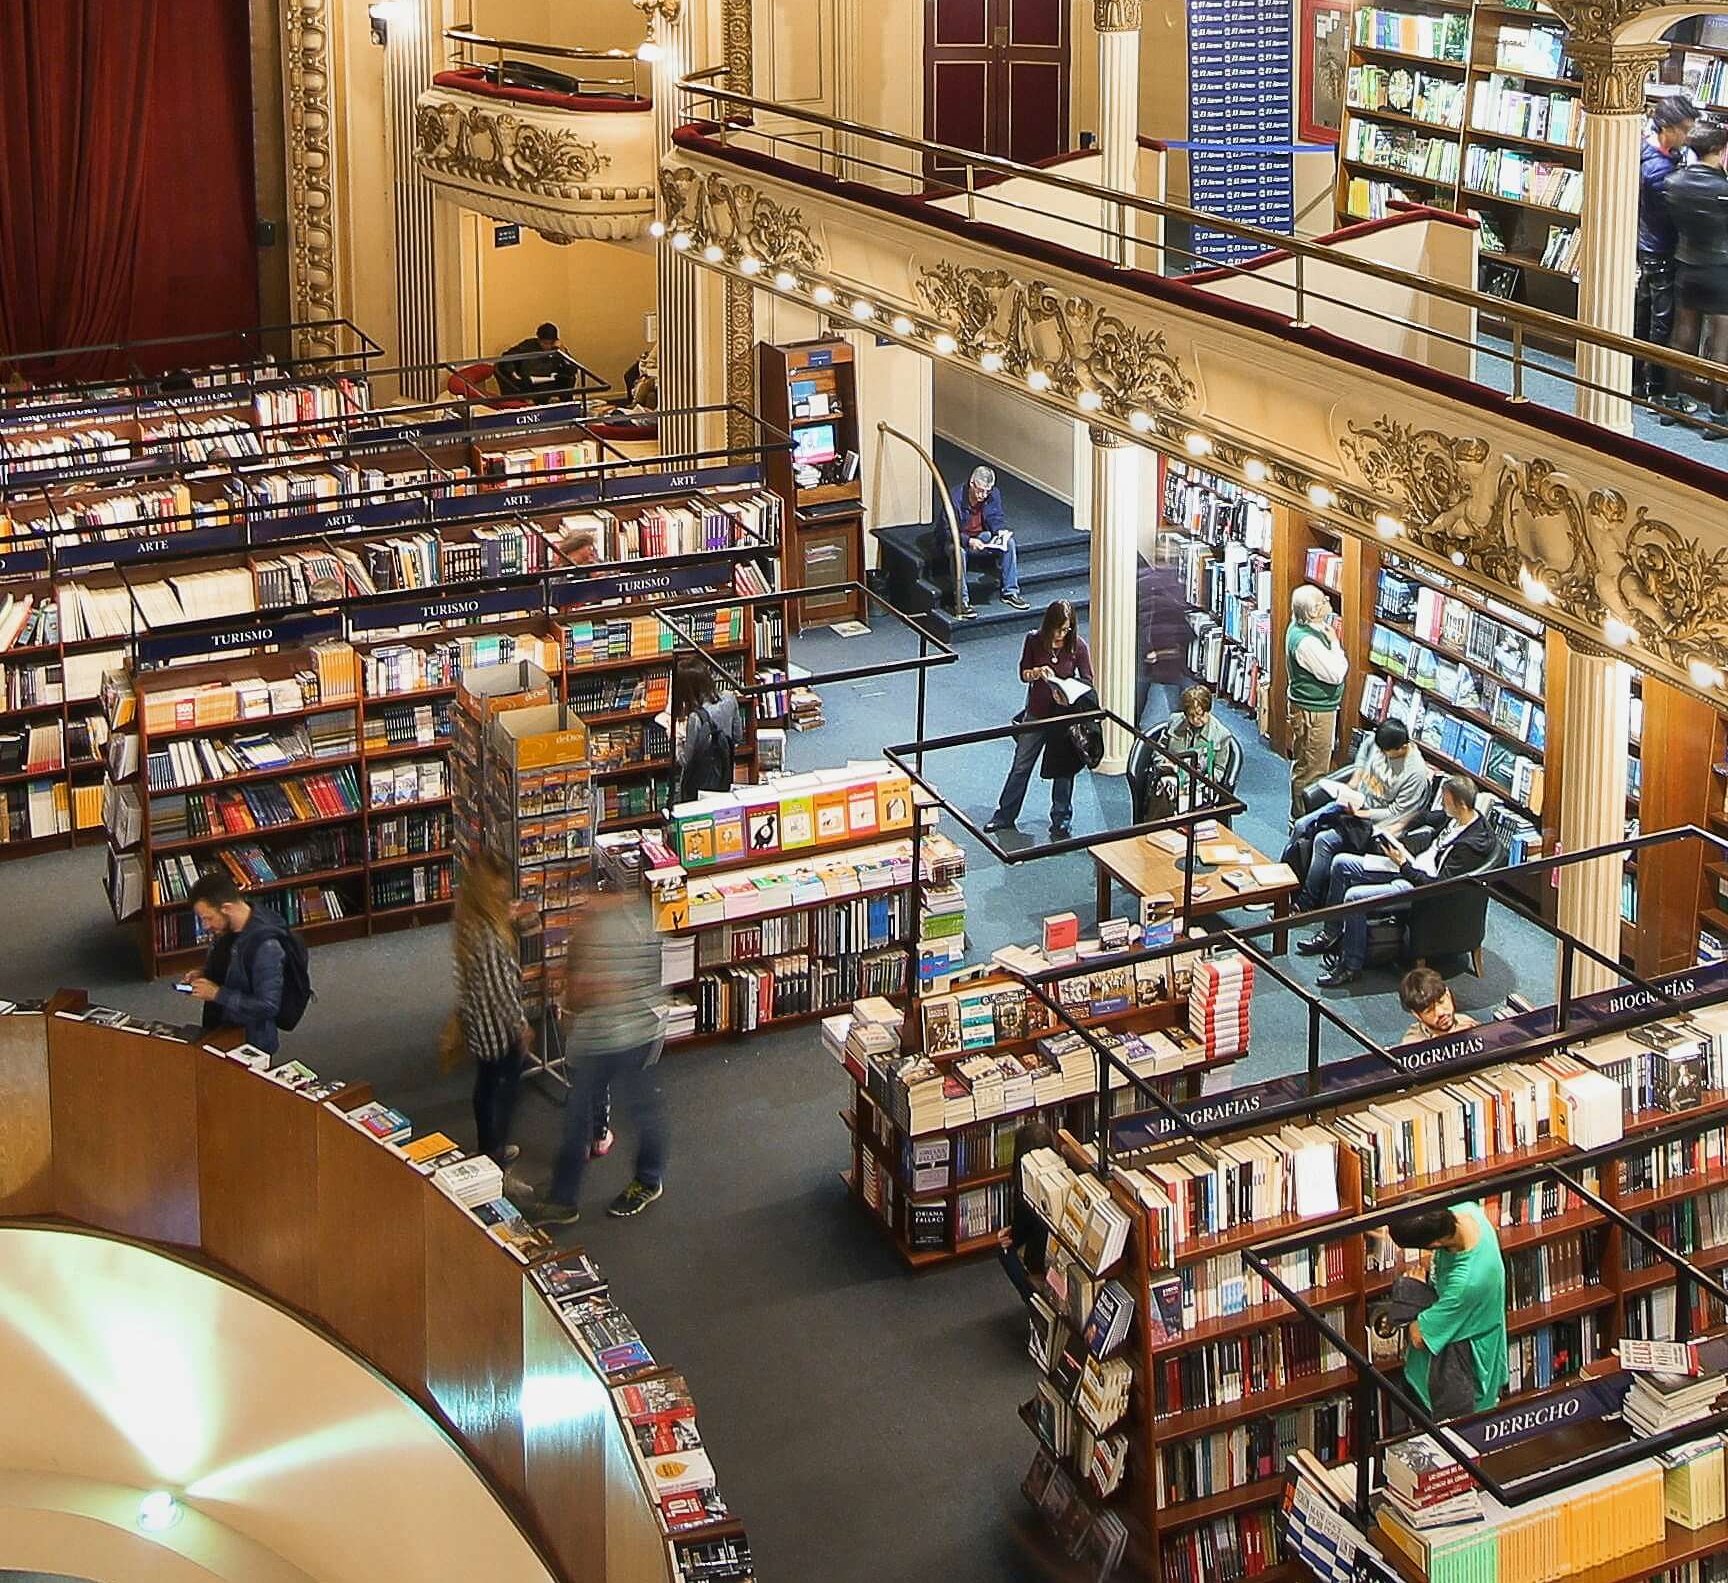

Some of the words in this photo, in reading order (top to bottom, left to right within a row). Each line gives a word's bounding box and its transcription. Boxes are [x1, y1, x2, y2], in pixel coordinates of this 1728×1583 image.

[516, 413, 541, 425] CINE
[398, 429, 423, 440] CINE
[670, 474, 697, 486] ARTE
[503, 494, 532, 506] ARTE
[325, 514, 355, 527] ARTE
[137, 540, 169, 553] ARTE
[616, 575, 671, 592] TURISMO
[420, 600, 479, 617] TURISMO
[211, 629, 273, 647] TURISMO
[1483, 1397, 1580, 1443] DERECHO
